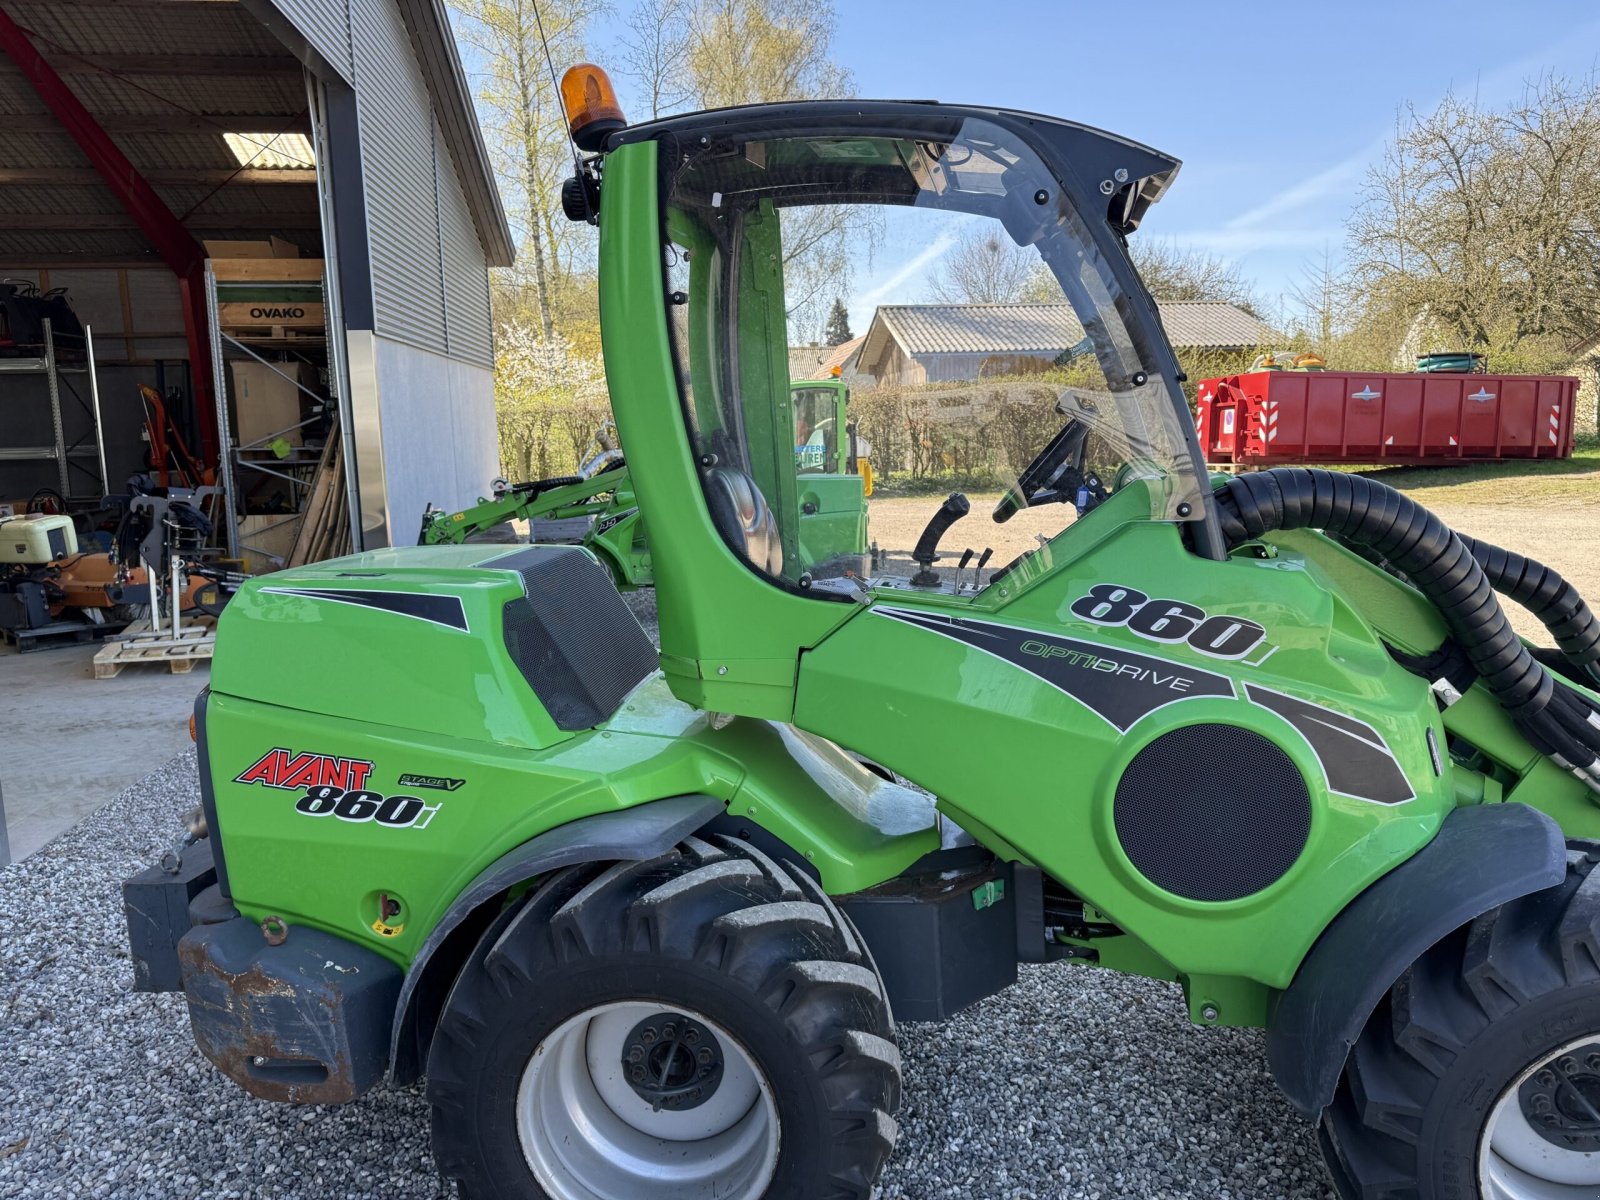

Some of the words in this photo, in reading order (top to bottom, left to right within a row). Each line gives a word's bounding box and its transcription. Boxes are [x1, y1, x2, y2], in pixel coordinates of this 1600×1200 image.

[250, 307, 305, 318] OVAKO
[1019, 640, 1195, 692] OPTIDRIVE
[234, 747, 373, 791] AVANT
